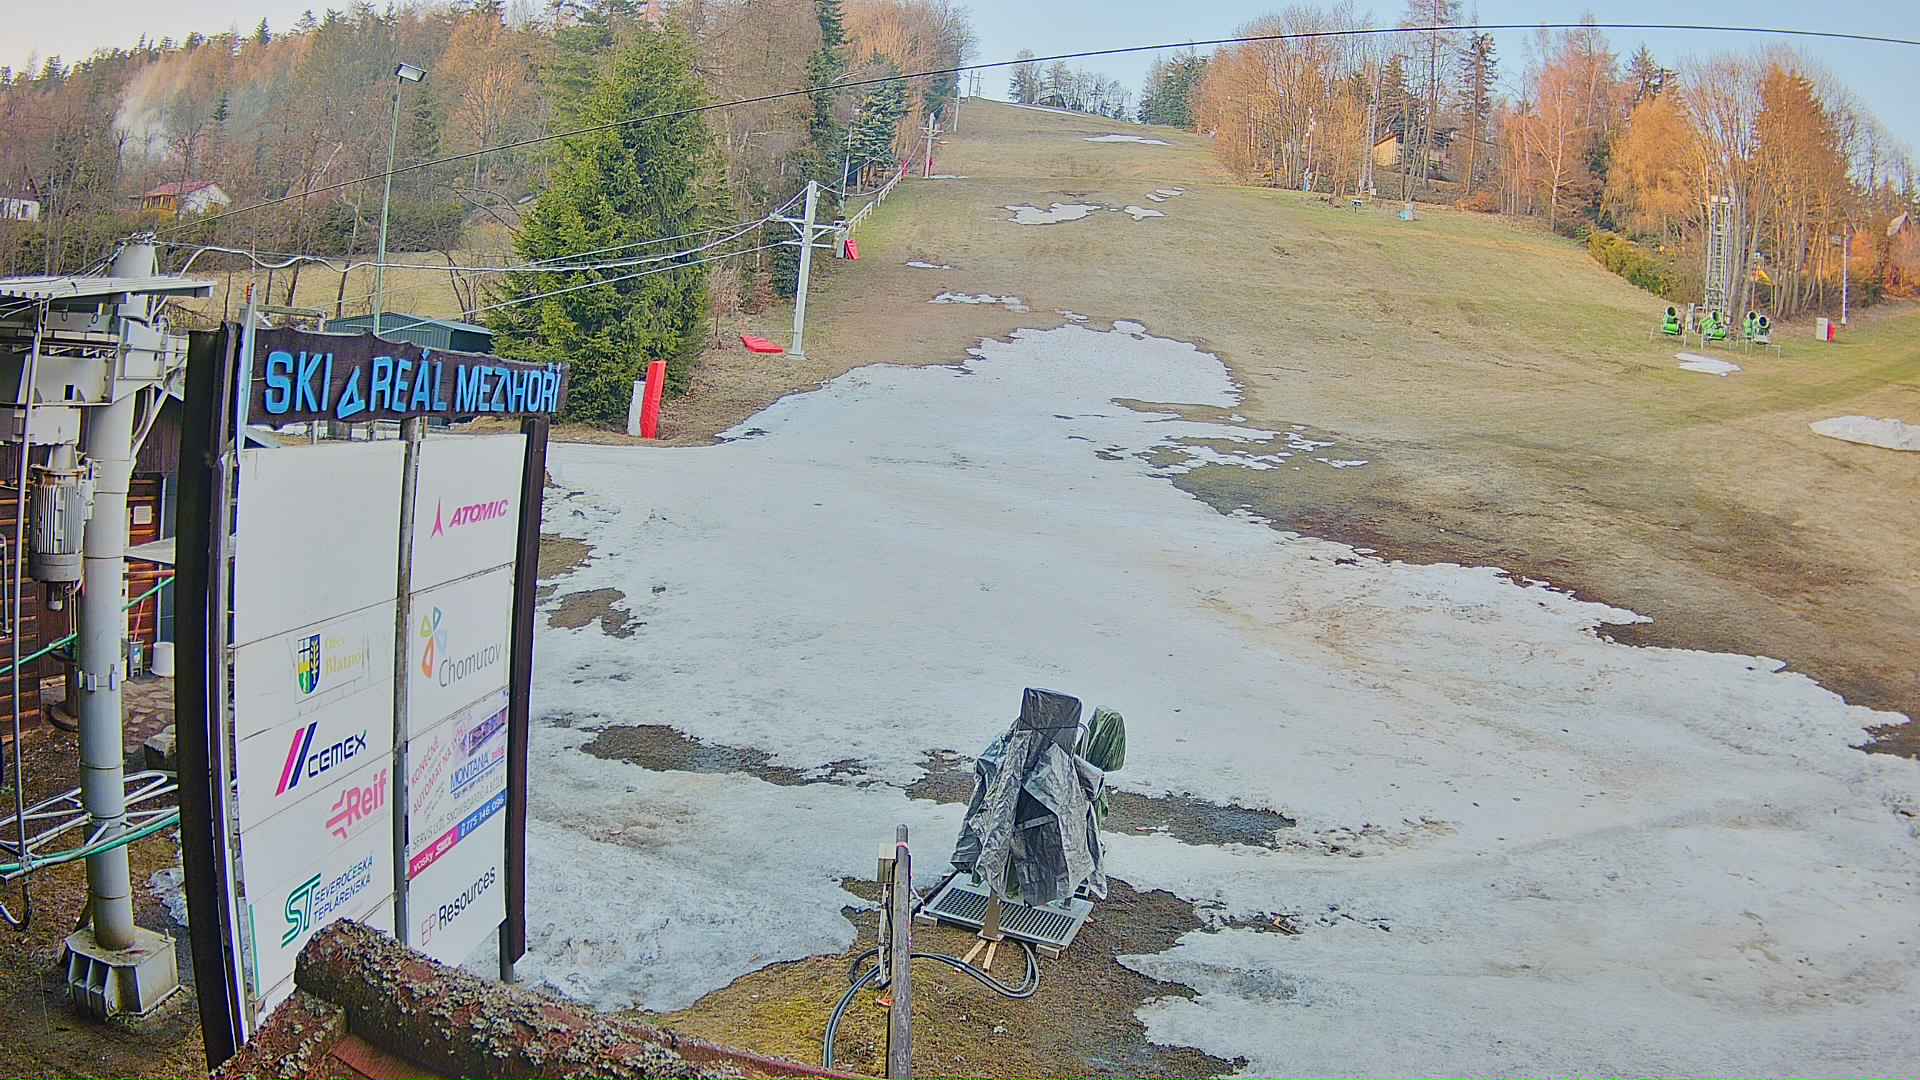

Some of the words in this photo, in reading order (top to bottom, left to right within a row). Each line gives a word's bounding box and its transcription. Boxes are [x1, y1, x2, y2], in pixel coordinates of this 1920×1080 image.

[264, 351, 333, 415] SKI
[337, 347, 449, 419] AREÁL
[449, 498, 509, 528] ATOMIC
[439, 643, 501, 688] Chomutov
[308, 730, 367, 779] CEMEX
[450, 752, 489, 788] MONTANA
[346, 769, 387, 826] Reif
[421, 911, 437, 947] EP
[438, 865, 497, 931] Resources
